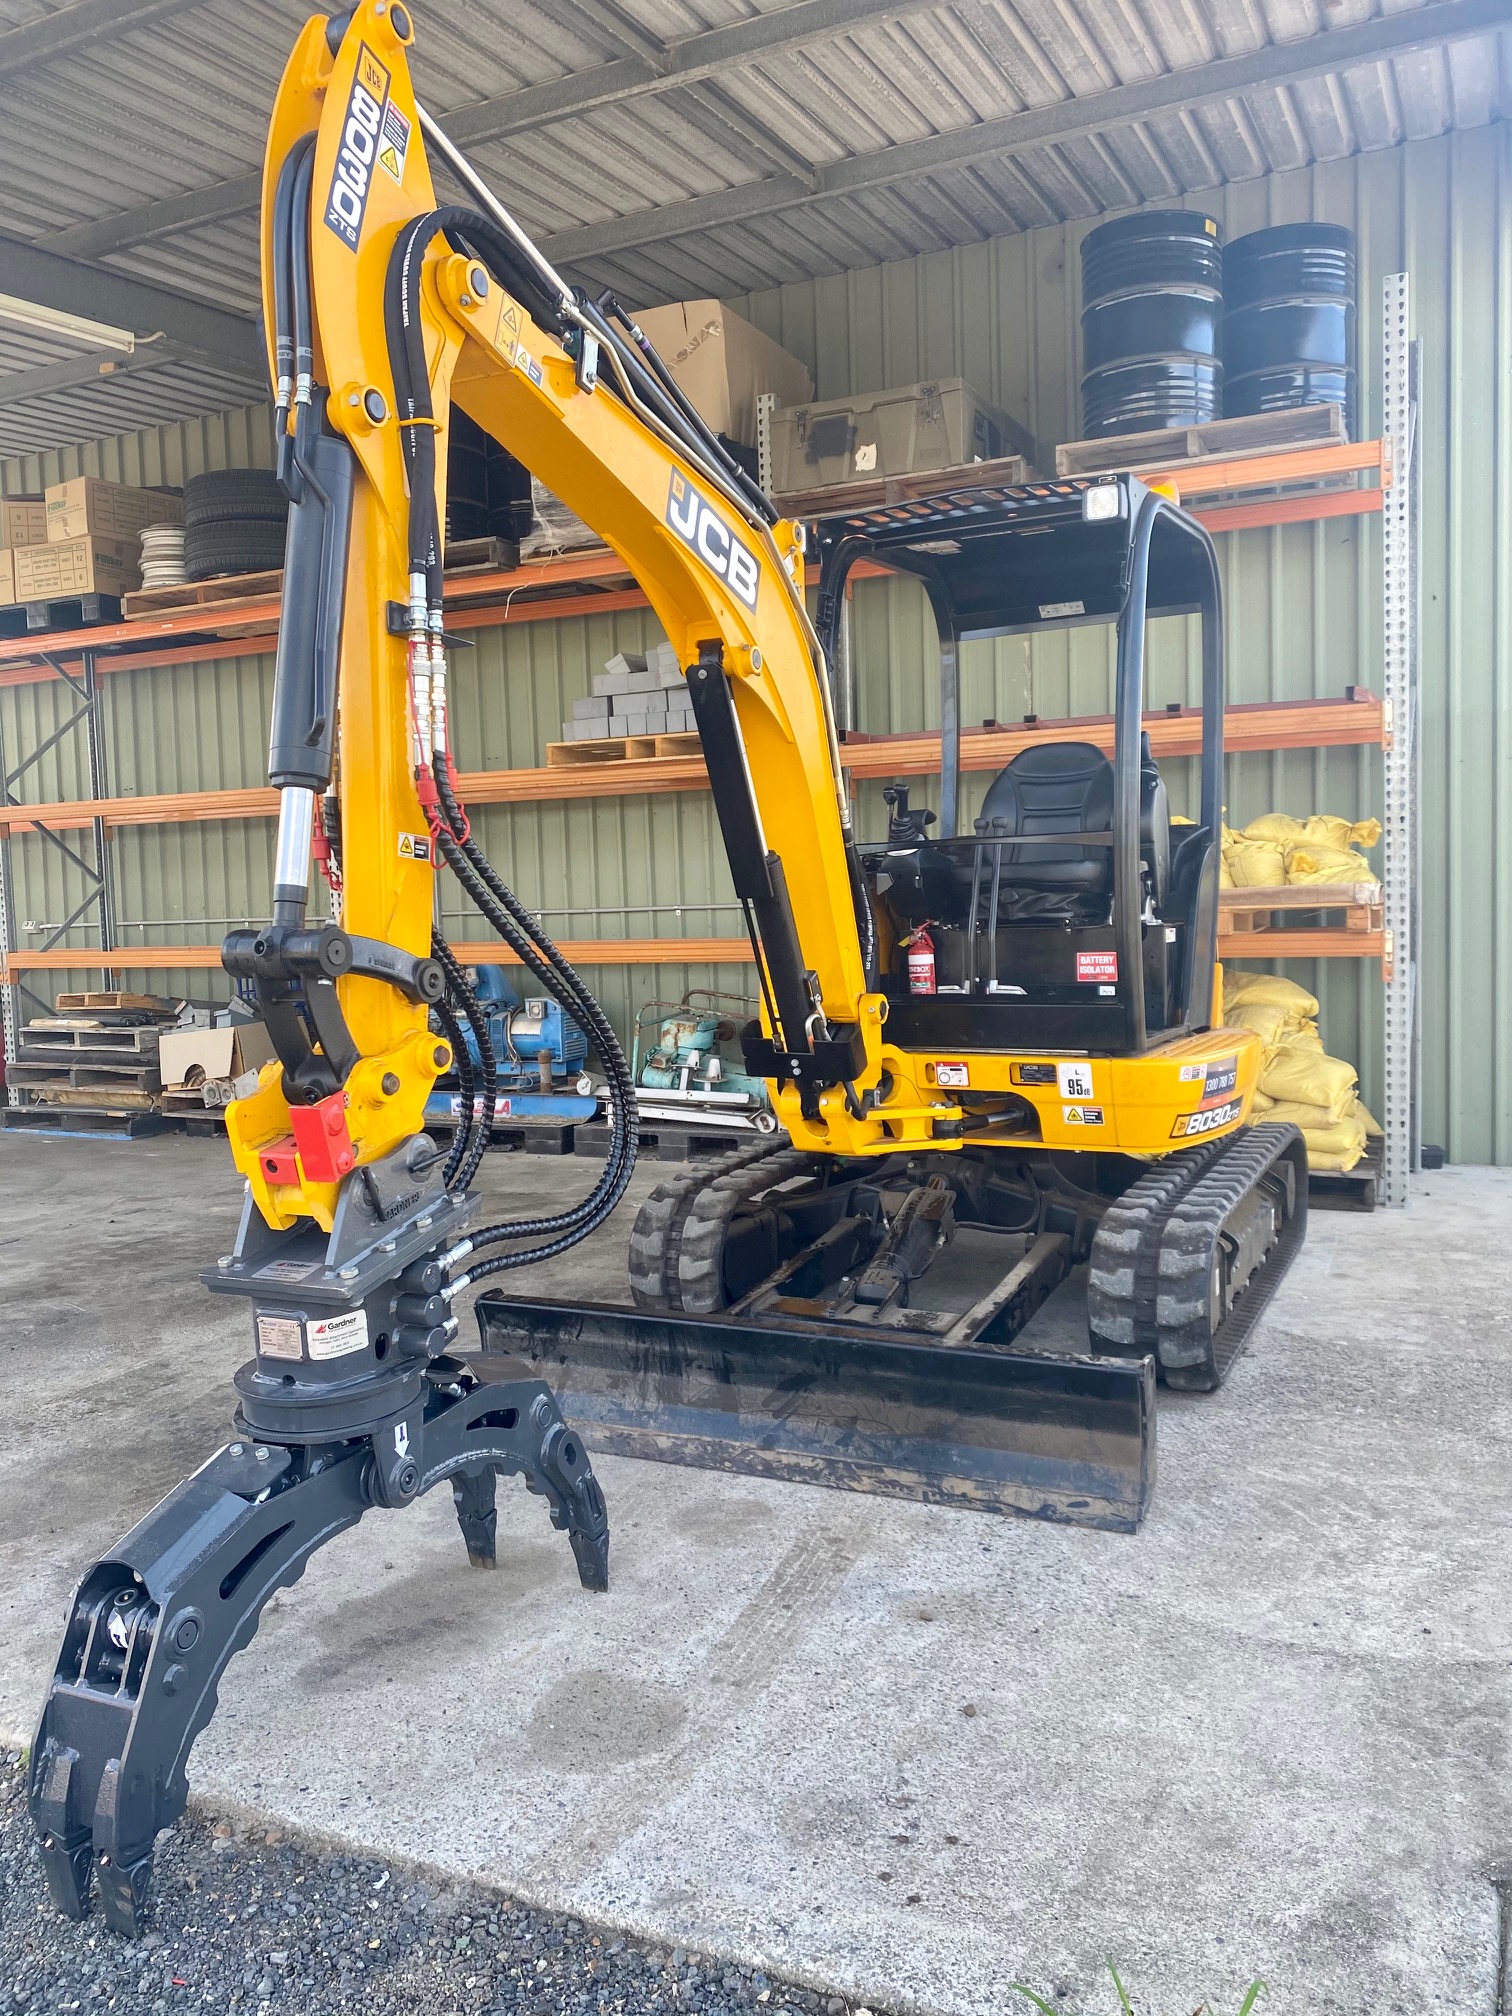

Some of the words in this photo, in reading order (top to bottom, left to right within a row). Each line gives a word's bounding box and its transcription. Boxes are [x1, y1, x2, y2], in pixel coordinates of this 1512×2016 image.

[365, 62, 381, 87] JCB
[332, 85, 381, 228] 8030
[328, 208, 357, 243] ZTS
[670, 490, 758, 605] JCB
[76, 554, 84, 562] 12
[78, 573, 84, 581] 6
[1080, 955, 1114, 965] BATTERY
[1080, 965, 1116, 974] ISOLATOR
[1067, 1078, 1084, 1096] 95
[1083, 1088, 1091, 1096] dB
[1205, 1077, 1219, 1092] 1300
[1186, 1104, 1231, 1135] 8030
[1226, 1106, 1241, 1123] ZTS
[385, 1191, 421, 1220] ARDNER
[327, 1317, 357, 1330] Gardner
